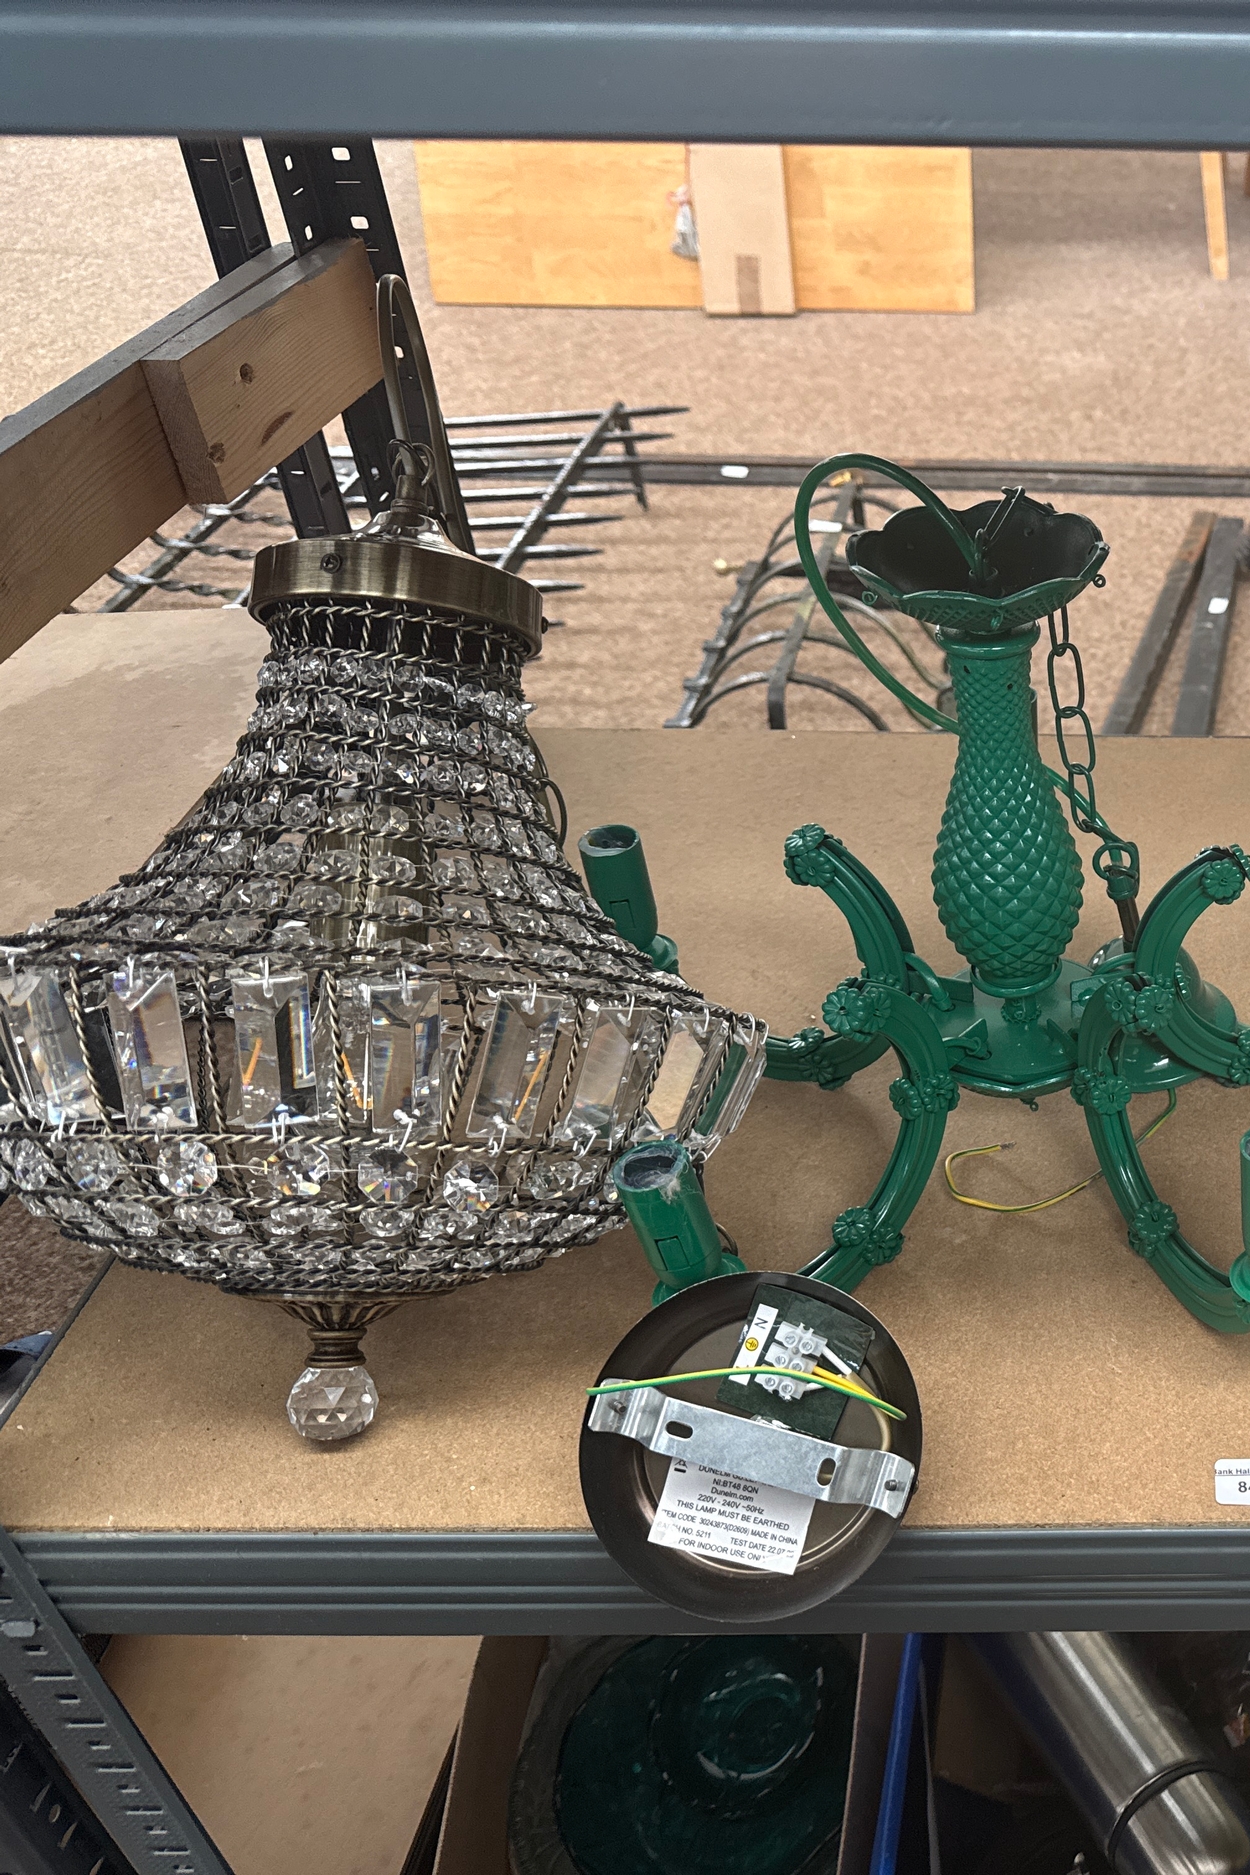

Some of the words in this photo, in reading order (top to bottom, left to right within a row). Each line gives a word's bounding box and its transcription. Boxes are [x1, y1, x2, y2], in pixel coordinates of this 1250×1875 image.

[754, 1317, 768, 1329] N
[710, 1486, 754, 1502] Dunelm.com
[742, 1484, 760, 1494] 8QN
[697, 1493, 717, 1504] 220V
[722, 1499, 742, 1510] 240V
[676, 1499, 694, 1510] THIS
[695, 1504, 718, 1515] LAMP
[718, 1510, 740, 1520] MUST
[740, 1514, 752, 1523] BE
[752, 1516, 790, 1532] EARTHED
[678, 1512, 697, 1523] CODE
[750, 1529, 769, 1540] MADE
[770, 1532, 778, 1541] IN
[778, 1534, 798, 1546] CHINA
[681, 1526, 694, 1536] NO.
[695, 1529, 712, 1539] 5211
[730, 1536, 748, 1548] TEST
[748, 1540, 768, 1552] DATE
[678, 1537, 697, 1548] FOR
[696, 1540, 729, 1556] INDOOR
[730, 1547, 746, 1560] USE
